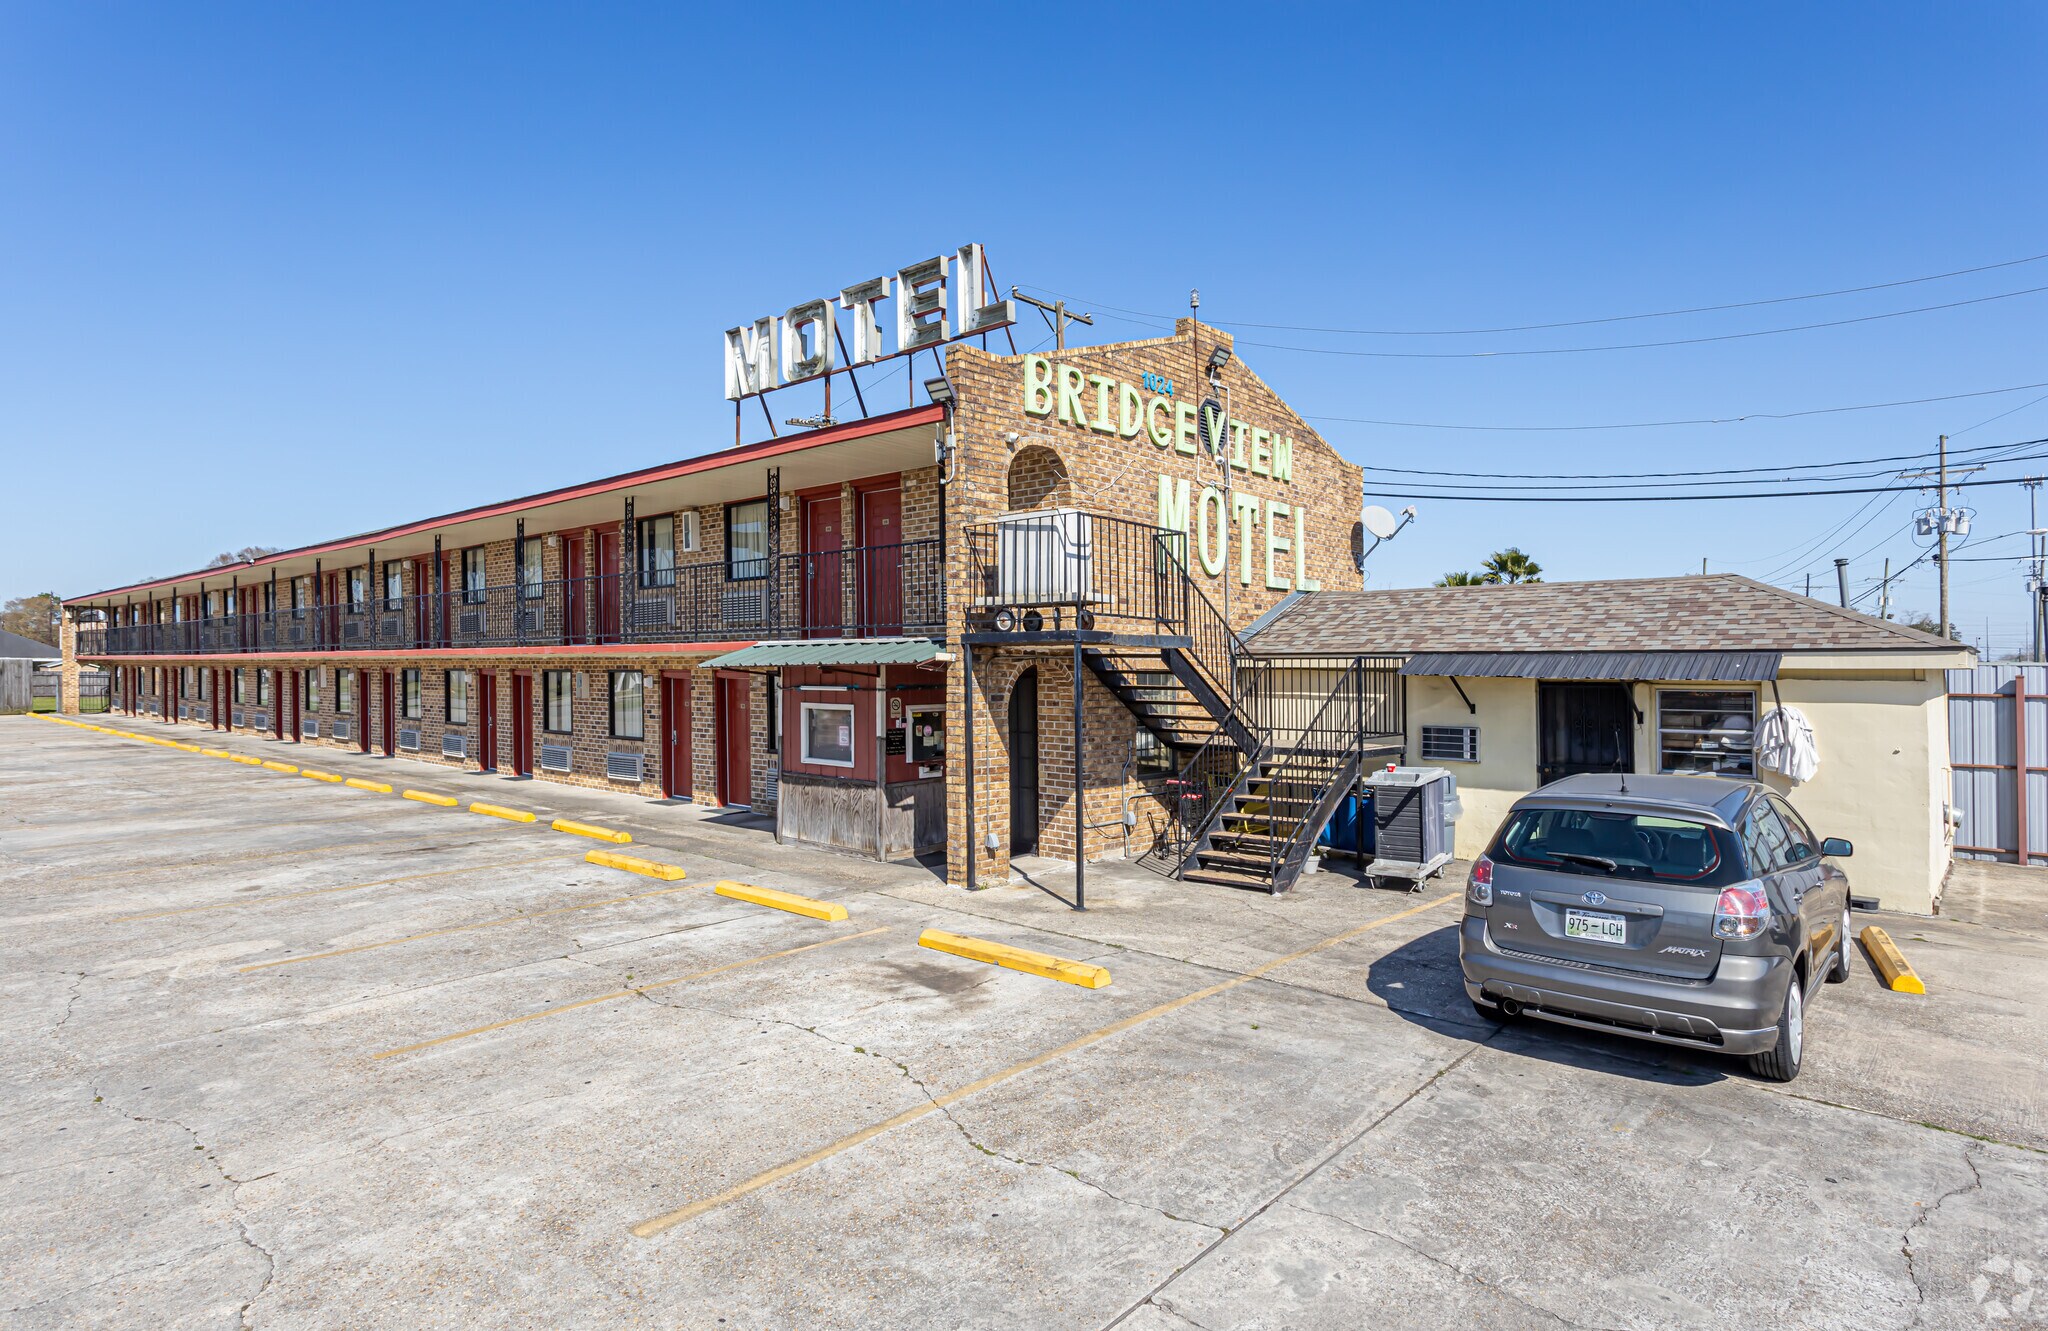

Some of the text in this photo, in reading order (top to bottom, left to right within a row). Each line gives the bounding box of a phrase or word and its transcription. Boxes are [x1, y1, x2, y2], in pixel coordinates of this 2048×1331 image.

[724, 243, 1016, 401] MOTEL
[1141, 370, 1174, 397] 1024
[1158, 473, 1321, 592] MOTEL
[1500, 889, 1521, 898] TOYOTA
[1657, 946, 1710, 958] MATRIX
